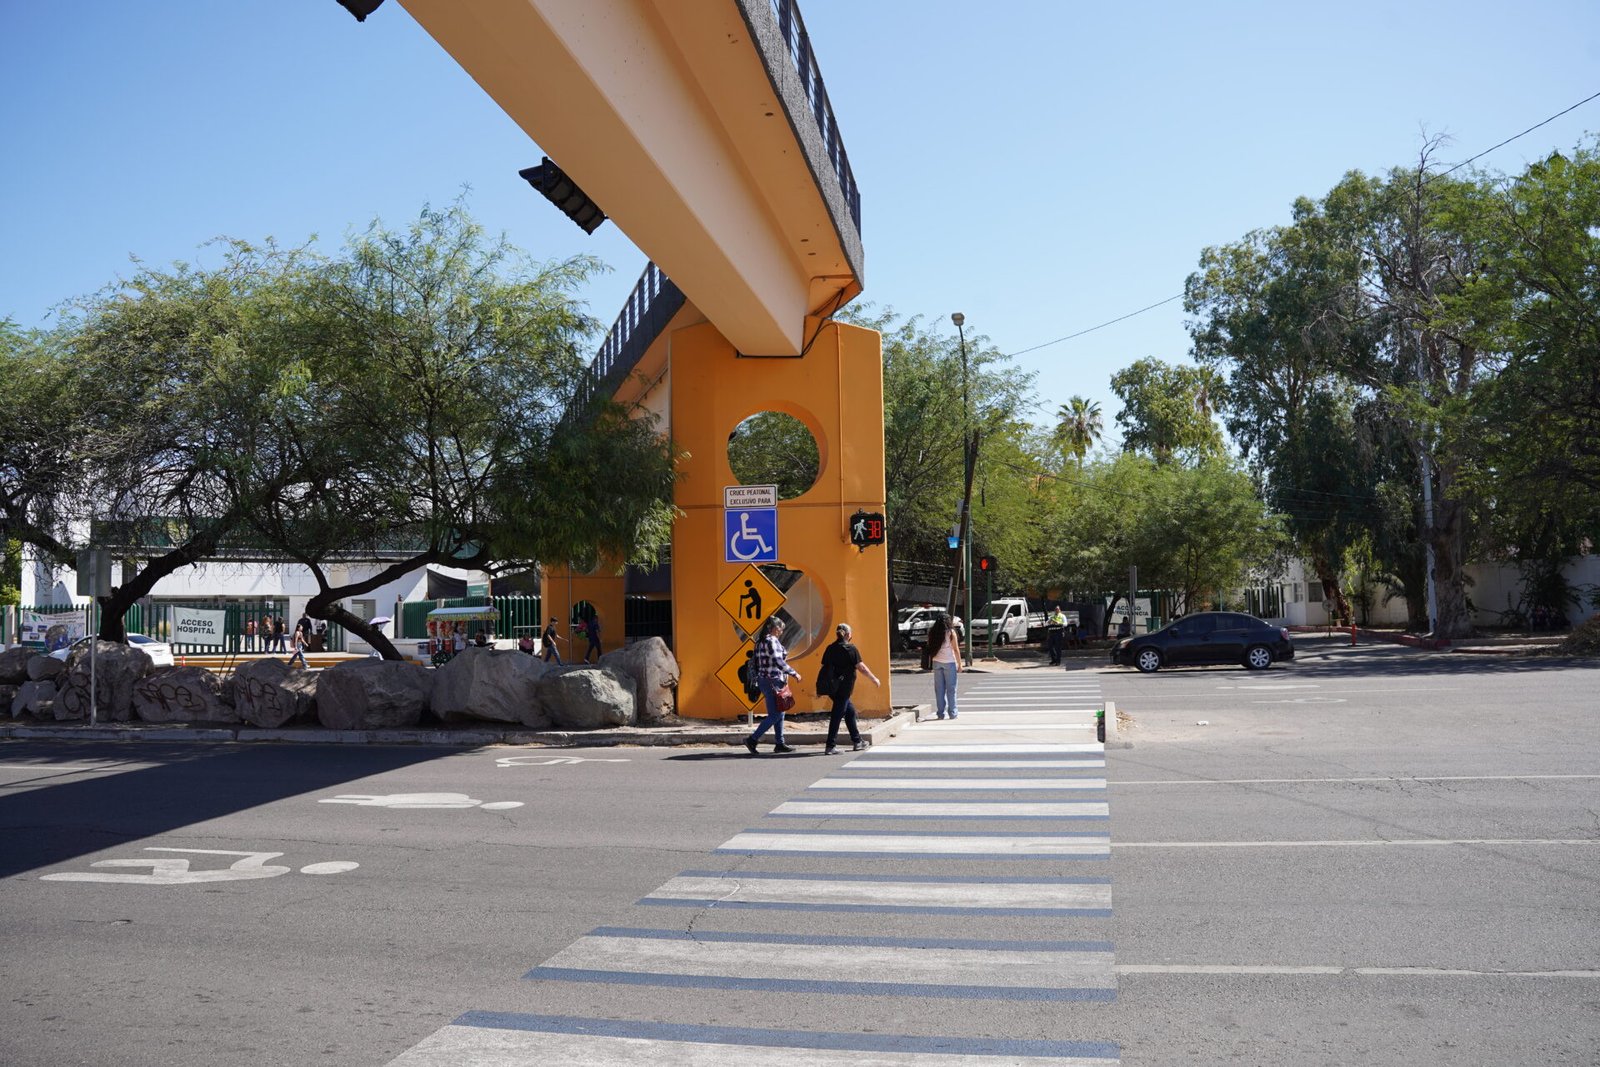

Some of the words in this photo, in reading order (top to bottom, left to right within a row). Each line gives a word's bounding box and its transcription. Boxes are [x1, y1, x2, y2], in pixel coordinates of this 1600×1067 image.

[867, 521, 881, 538] 38
[181, 619, 213, 627] ACCESO
[176, 626, 216, 634] HOSPITAL
